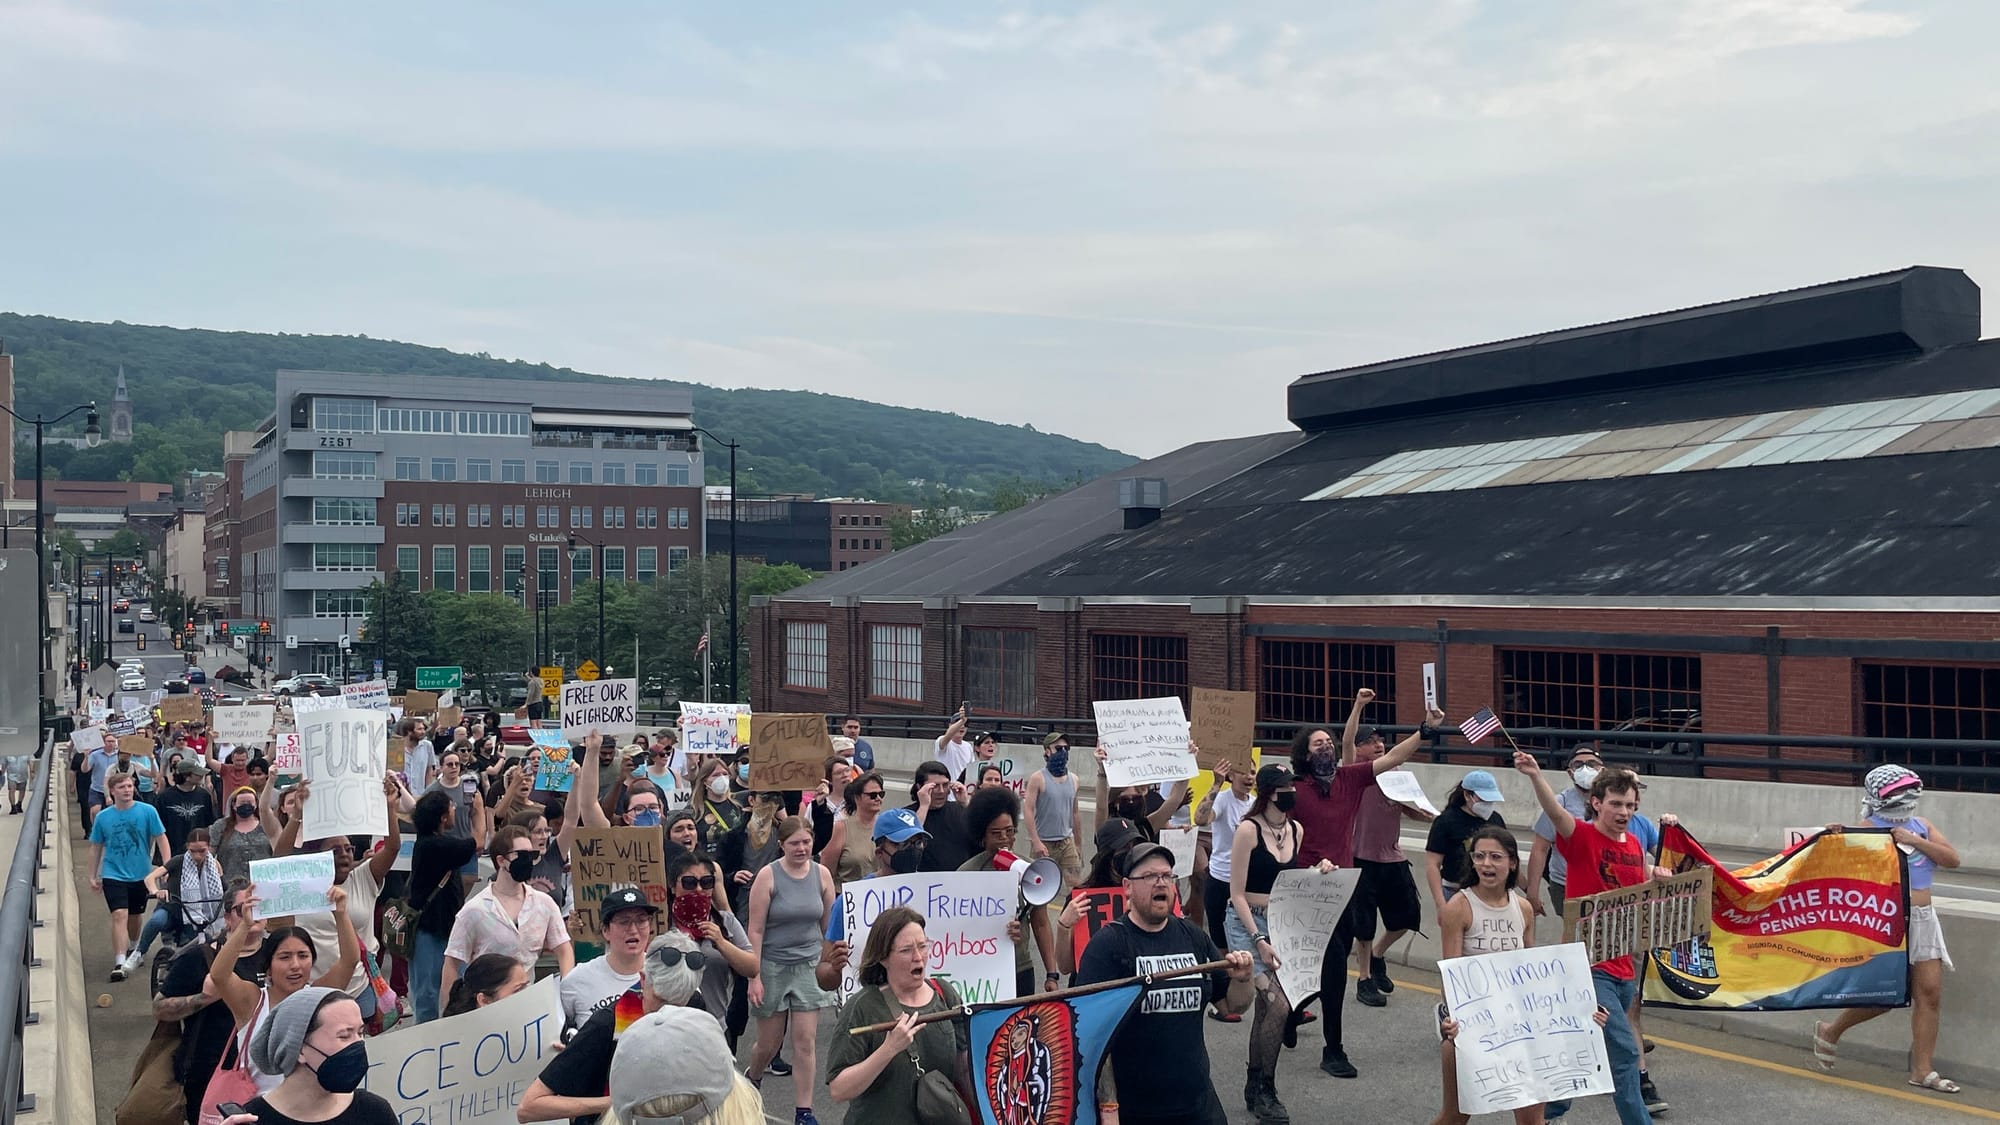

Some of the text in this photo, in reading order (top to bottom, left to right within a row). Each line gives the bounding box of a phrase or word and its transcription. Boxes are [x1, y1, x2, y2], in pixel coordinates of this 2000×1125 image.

[320, 436, 353, 447] ZEST
[525, 487, 572, 498] LEHIGH
[544, 679, 559, 688] 20
[565, 683, 628, 707] FREE OUR
[224, 710, 234, 719] WE
[564, 705, 634, 729] NEIGHBORS
[221, 730, 264, 739] IMMIGRANTS
[759, 717, 824, 748] CHINGA
[304, 721, 385, 780] FUCK
[309, 779, 387, 833] ICE
[576, 838, 659, 863] WE WILL
[579, 862, 650, 883] NOT BE
[928, 884, 1006, 918] FRIENDS
[1580, 893, 1637, 918] DONALD
[1657, 879, 1703, 899] TRUMP
[1775, 888, 1898, 917] THE ROAD
[1482, 919, 1515, 934] FUCK
[1760, 909, 1892, 936] PENNSYLVANIA
[1155, 956, 1196, 976] JUSTICE
[1786, 945, 1832, 963] COMUNIDAD
[1448, 958, 1566, 1006] NO human
[1144, 989, 1200, 1010] NO PEACE
[474, 1014, 550, 1077] OUT
[1474, 1060, 1526, 1090] FUCK
